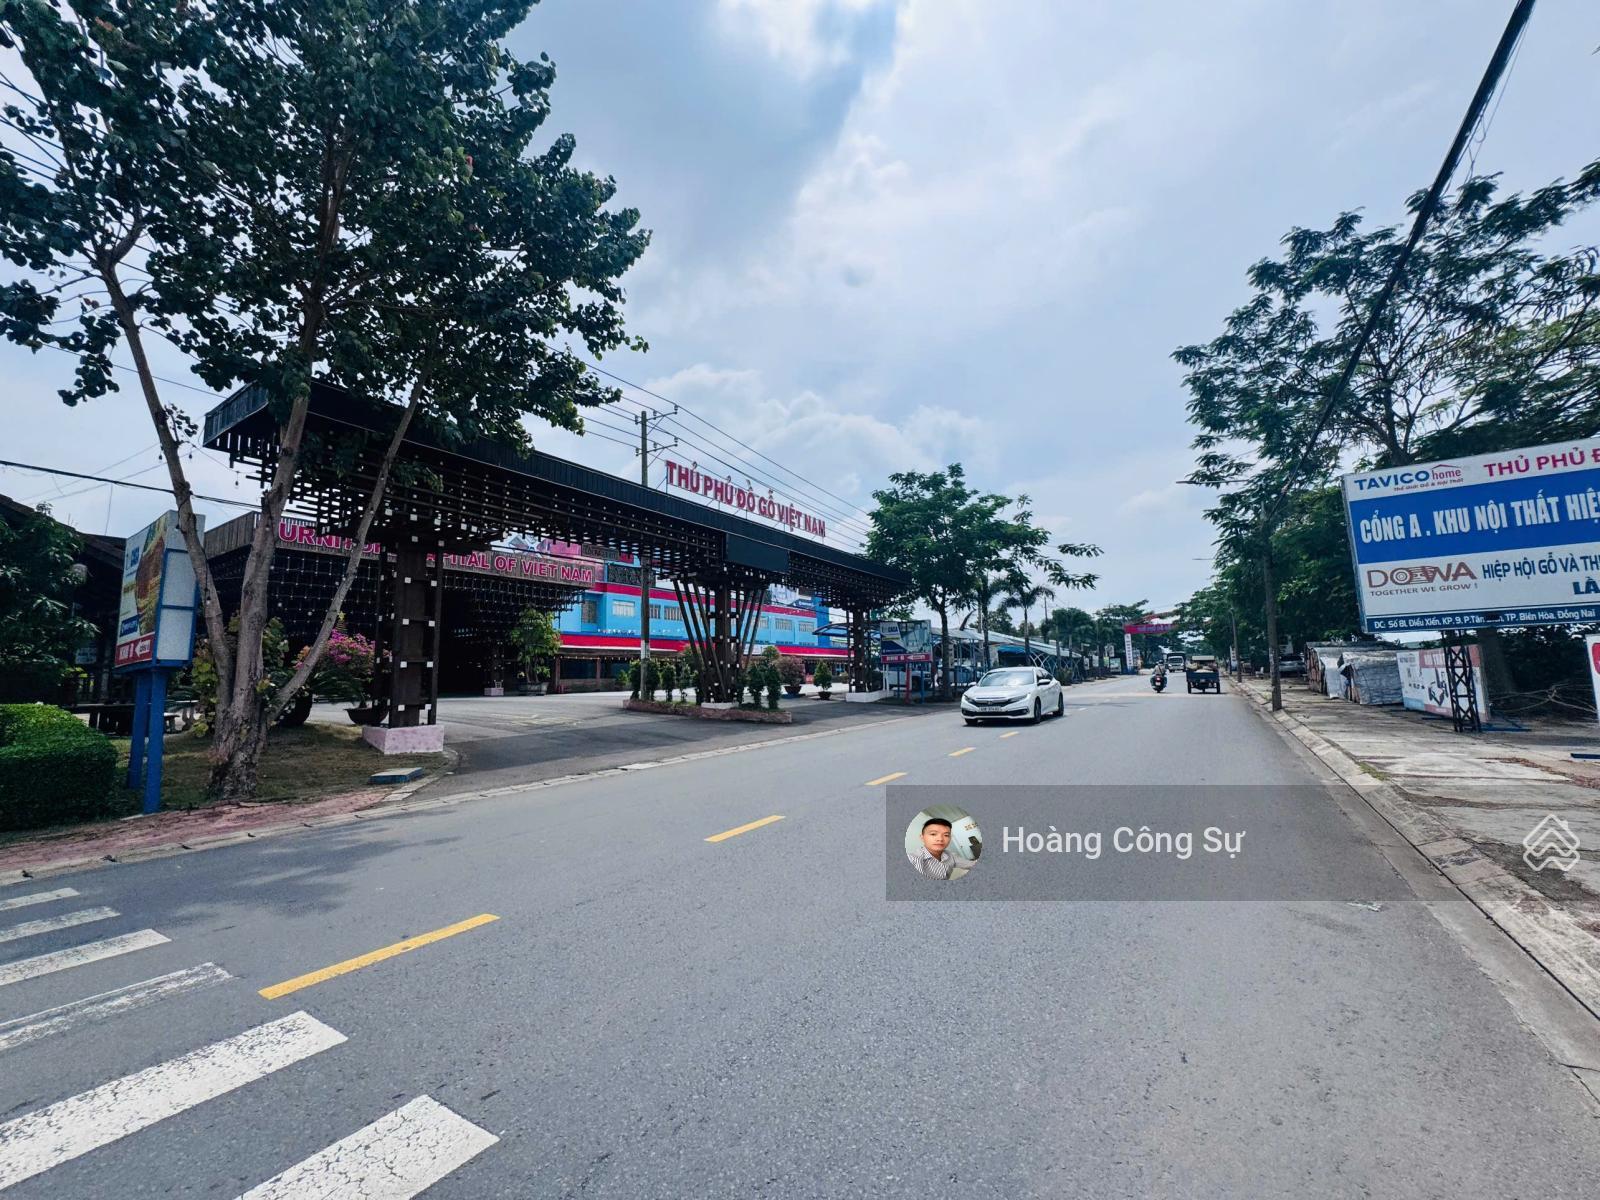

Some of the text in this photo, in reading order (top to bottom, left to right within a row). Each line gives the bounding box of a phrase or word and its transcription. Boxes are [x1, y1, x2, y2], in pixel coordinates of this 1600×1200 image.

[1484, 455, 1529, 477] THỦ
[1536, 447, 1585, 470] PHỦ
[1354, 469, 1462, 491] TAVICO home
[666, 460, 826, 537] THỦ PHỦ ĐỒ GỖ VIỆT NAM
[1360, 509, 1406, 543] CỔNG
[1433, 507, 1471, 535] KHU
[1474, 500, 1508, 534] NỘI
[1510, 489, 1560, 527] THẤT
[1565, 487, 1600, 524] HIỆ
[495, 555, 518, 572] OF
[521, 559, 558, 577] VIET
[561, 566, 593, 583] NAM
[1482, 552, 1600, 582] HIỆP HỘI GỖ VÀ TH
[1370, 587, 1418, 597] TOGETHER
[1421, 585, 1436, 593] WE
[1439, 583, 1471, 592] GROW
[1581, 608, 1596, 618] Nai
